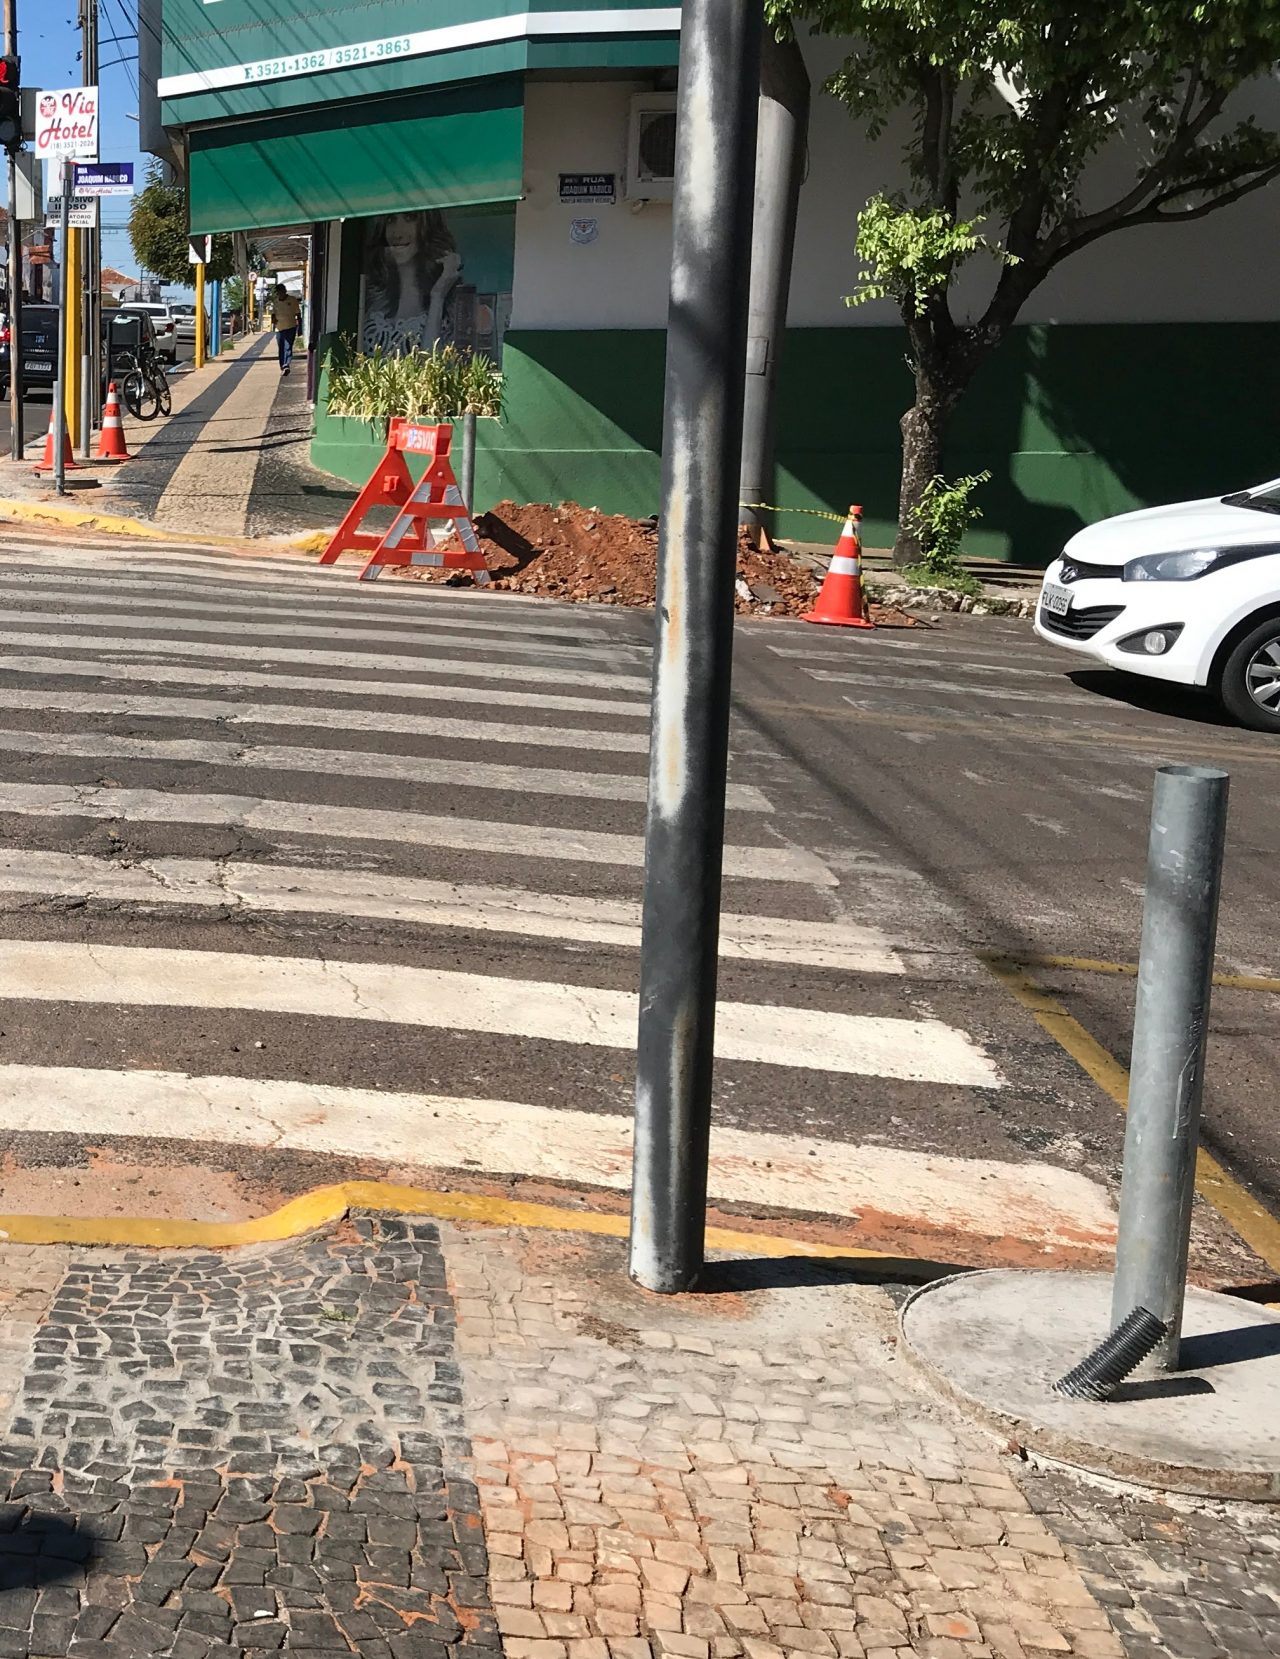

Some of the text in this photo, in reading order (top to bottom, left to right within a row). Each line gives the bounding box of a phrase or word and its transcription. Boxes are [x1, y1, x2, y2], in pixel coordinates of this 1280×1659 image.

[256, 54, 326, 78] 3521-1362
[335, 38, 411, 64] 3521-3863
[61, 91, 95, 115] Via
[38, 115, 95, 148] Hotel
[77, 174, 104, 185] JOAQUIM
